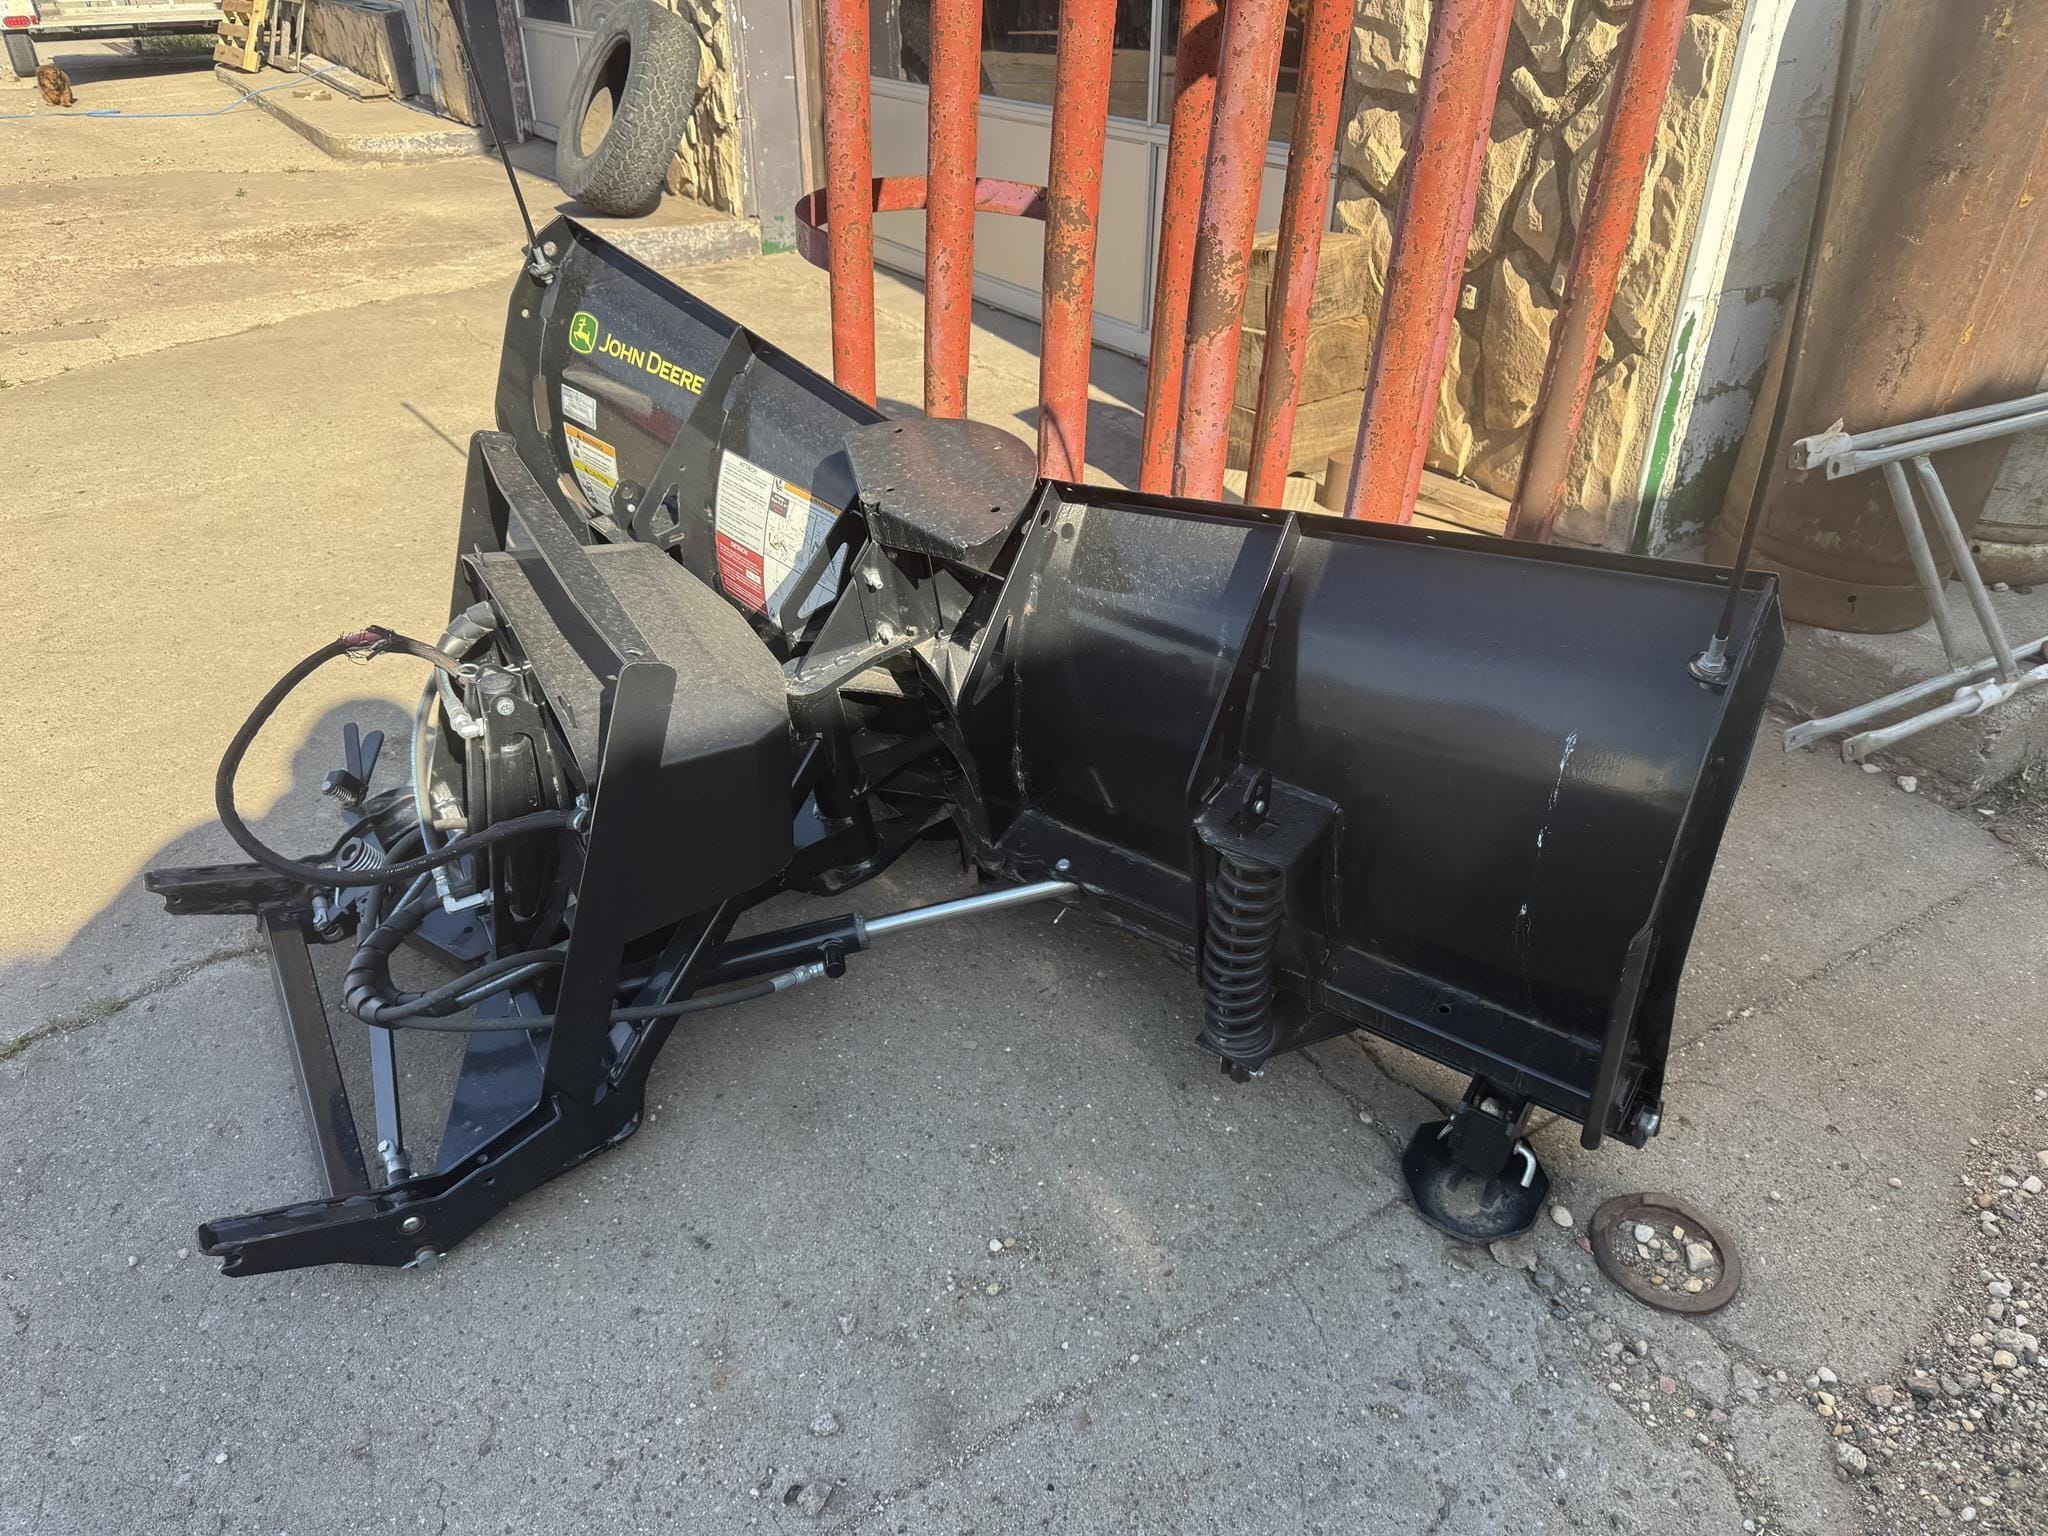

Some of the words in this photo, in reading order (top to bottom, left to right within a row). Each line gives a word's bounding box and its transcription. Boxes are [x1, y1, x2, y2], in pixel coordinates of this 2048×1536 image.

[598, 333, 645, 369] JOHN
[646, 350, 706, 396] DEERE
[739, 461, 758, 475] ATTACH
[813, 498, 837, 514] WARNING
